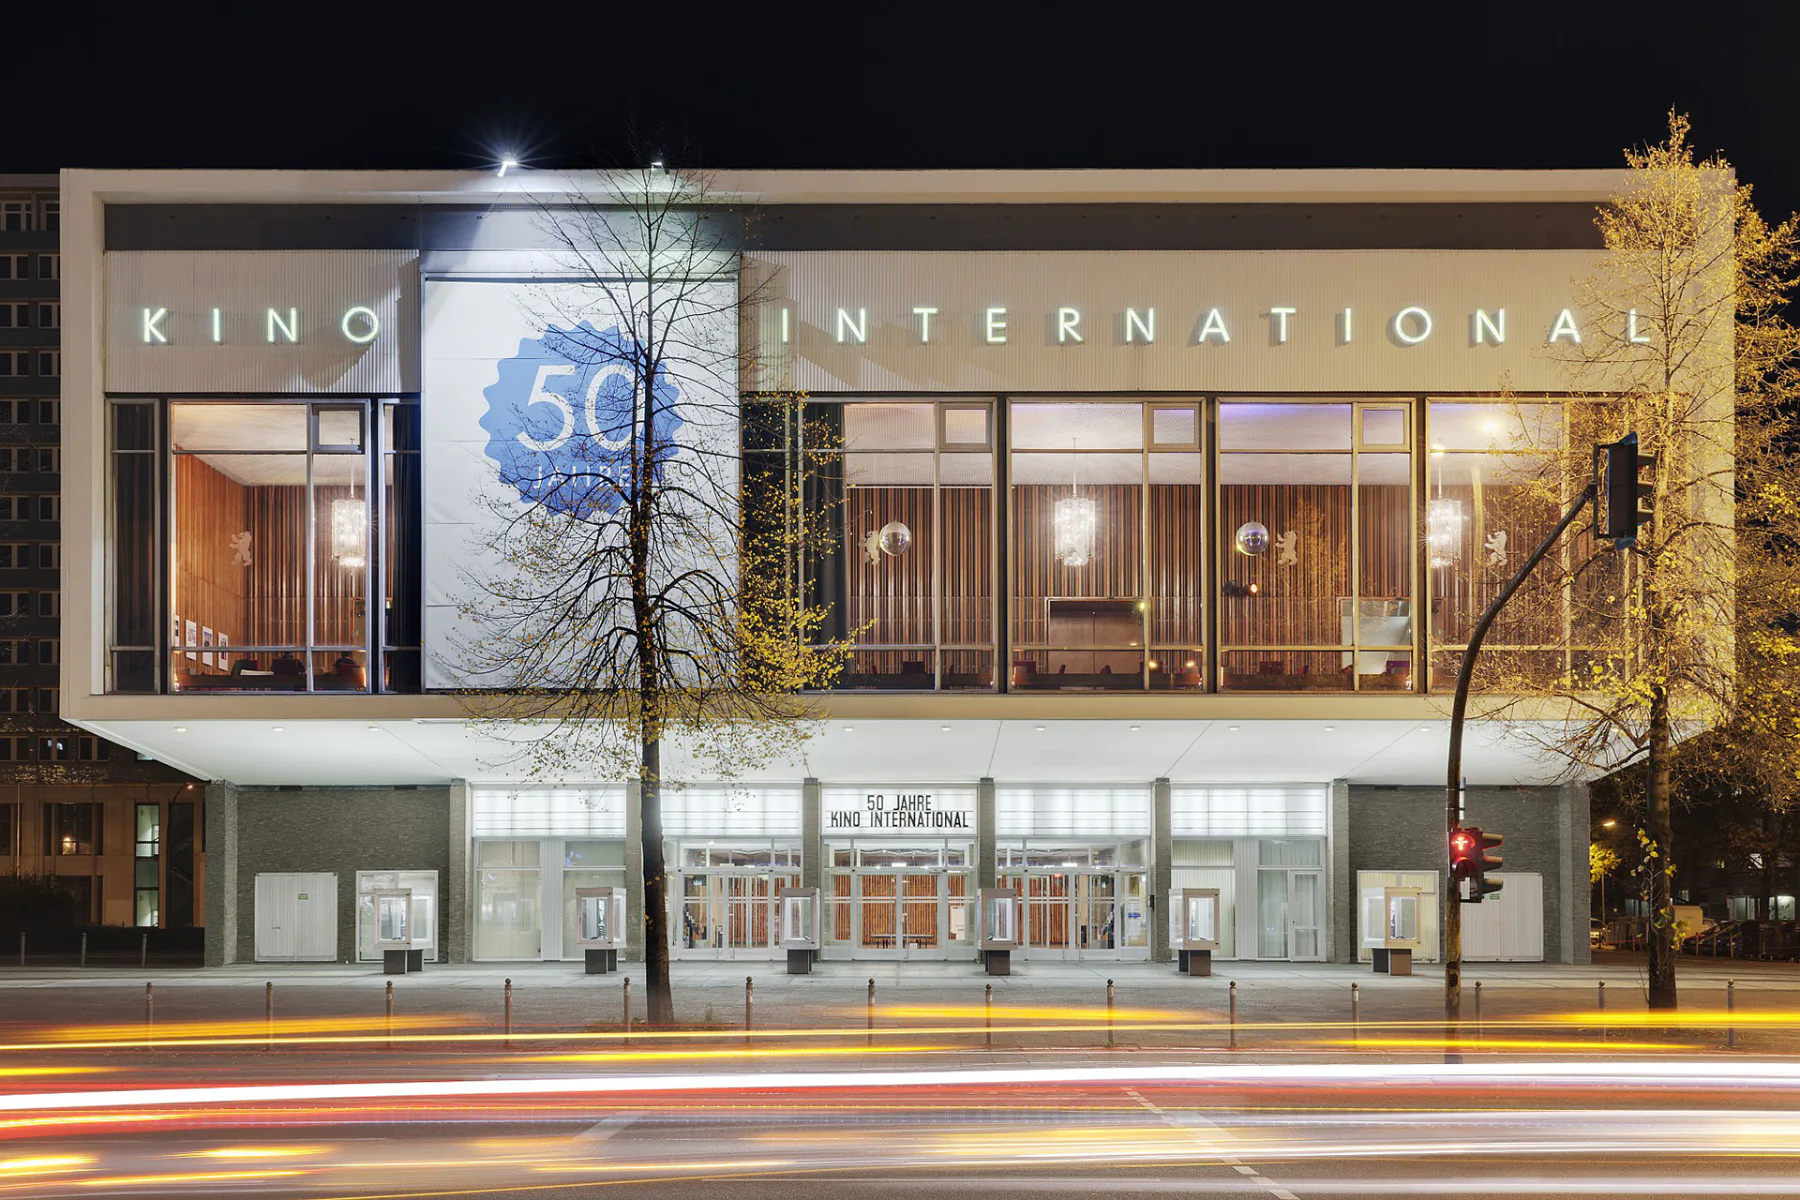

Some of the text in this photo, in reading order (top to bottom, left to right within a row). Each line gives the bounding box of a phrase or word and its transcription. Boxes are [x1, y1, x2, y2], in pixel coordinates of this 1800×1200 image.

[143, 306, 1651, 343] KINO INTERNATIONAL
[517, 364, 648, 451] 50
[867, 794, 931, 811] 50 JAHRE
[831, 811, 969, 828] KINO INTERNATIONAL
